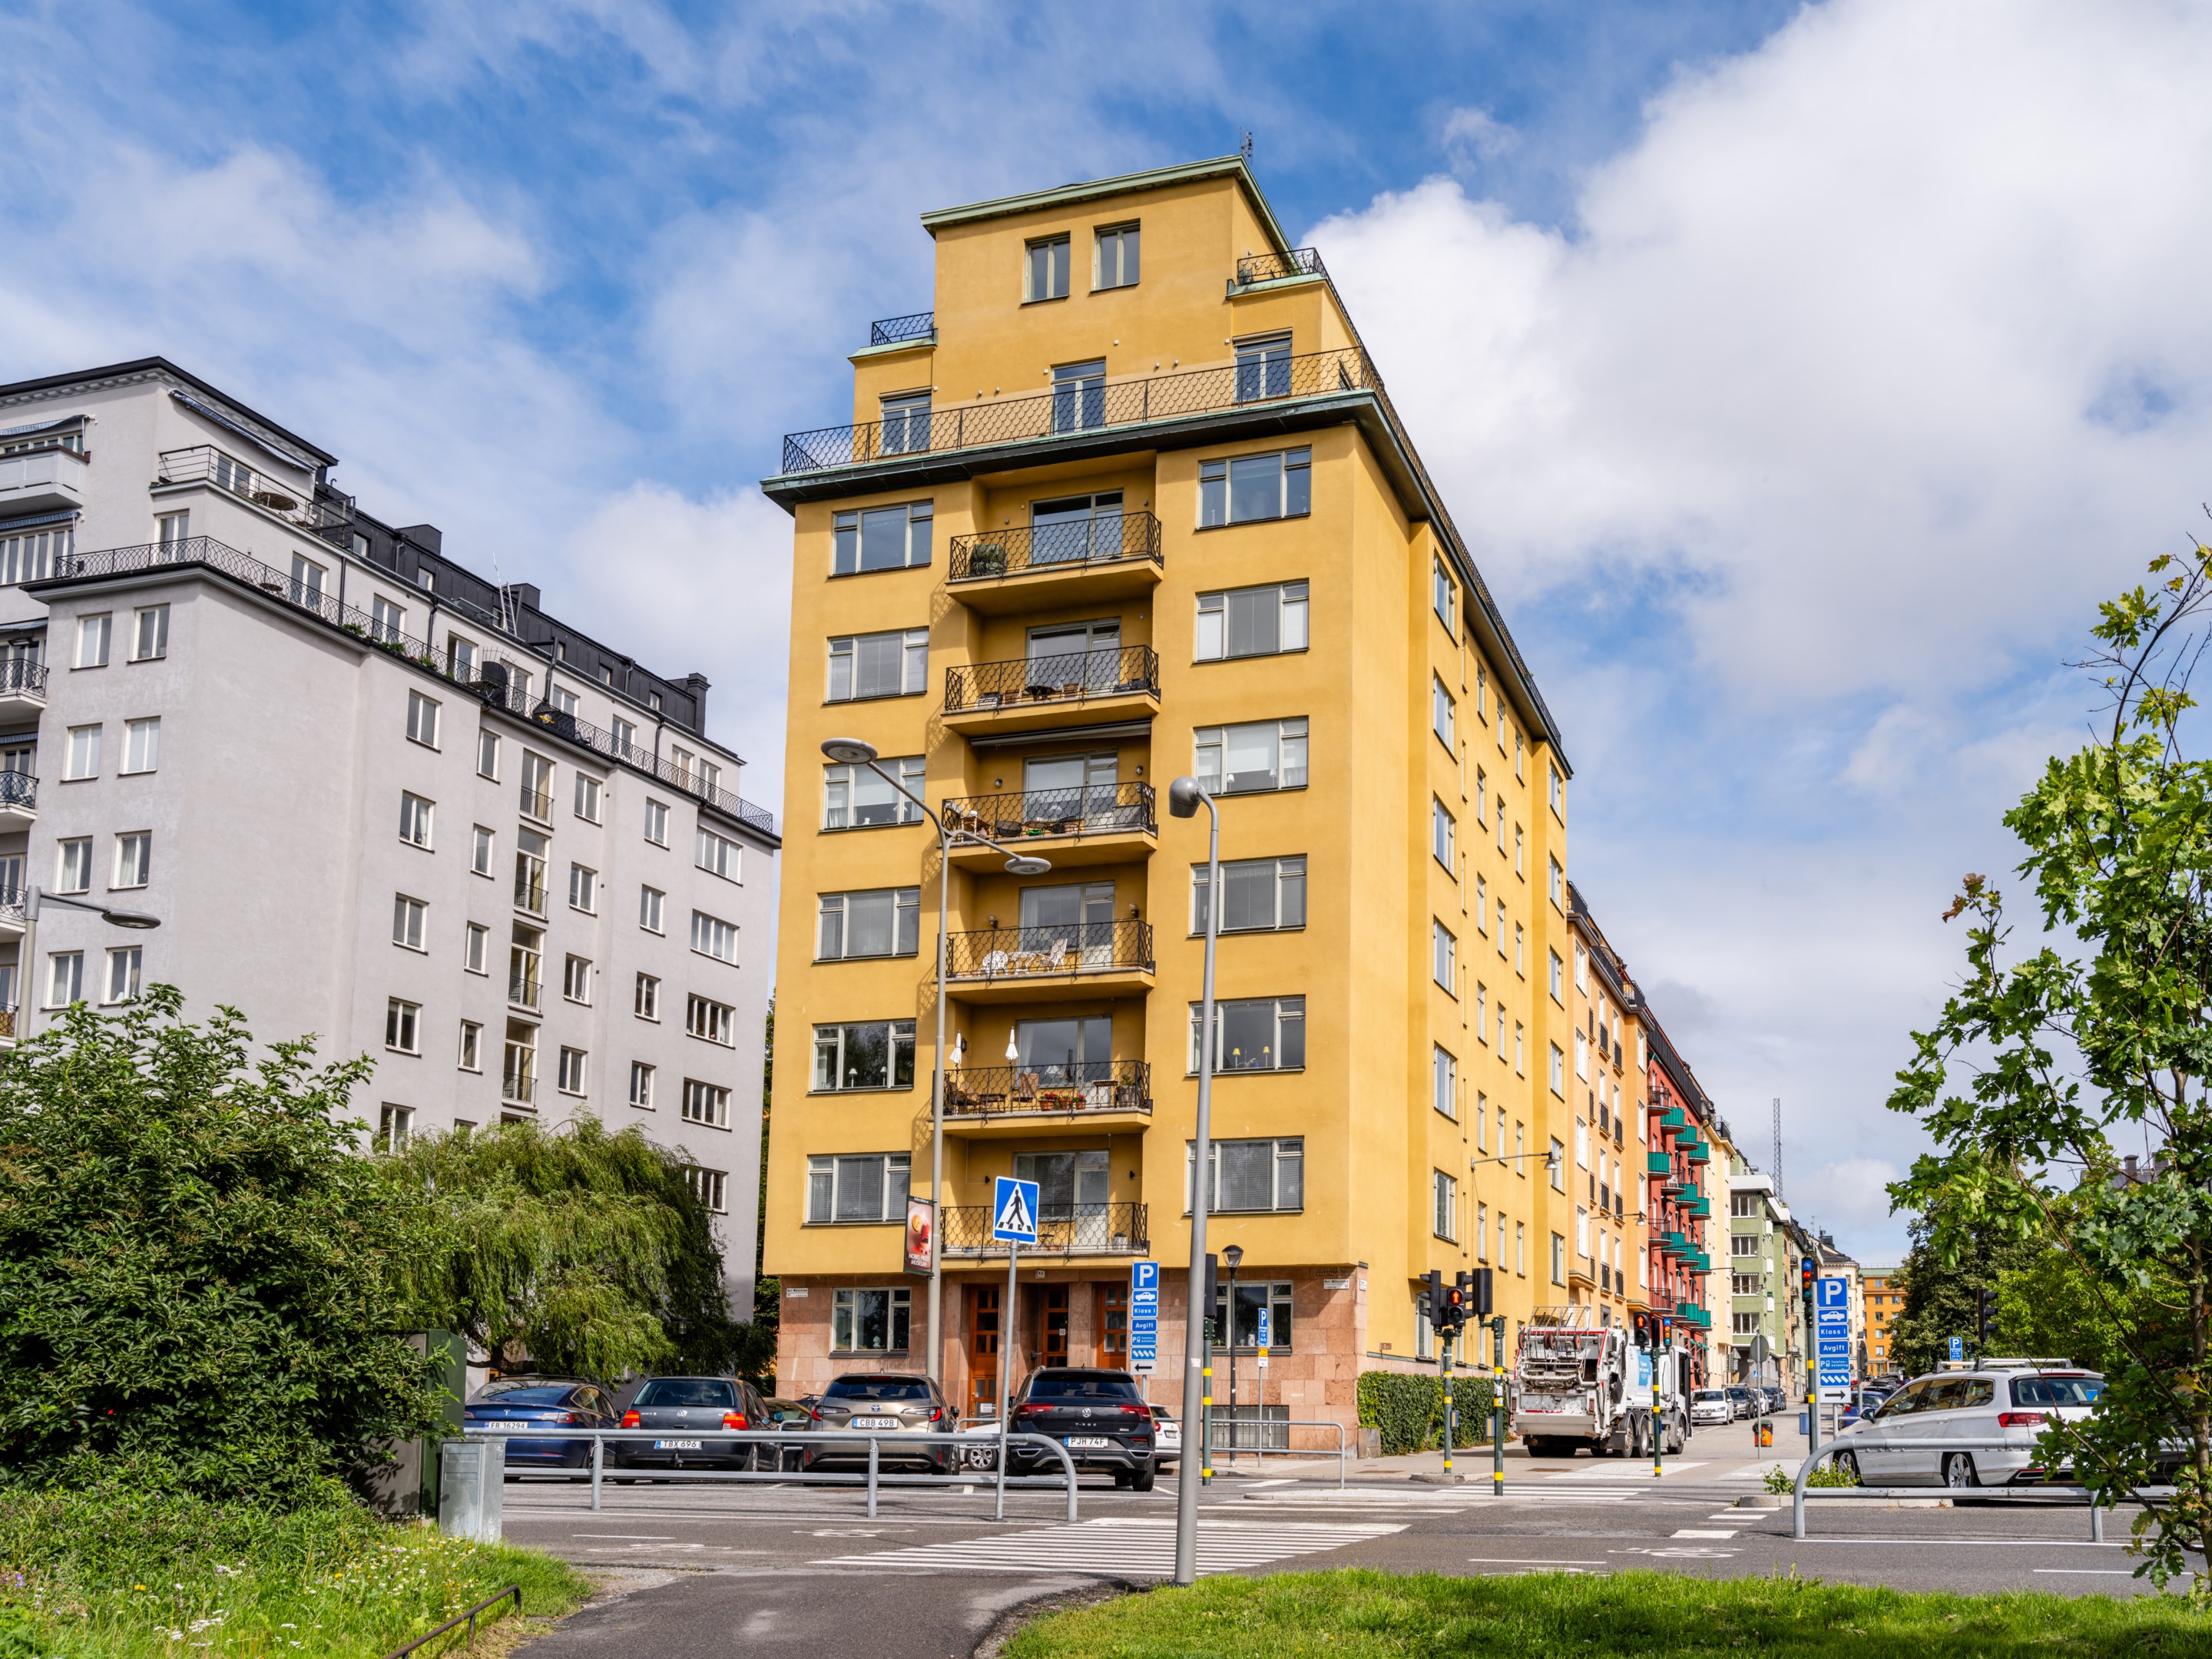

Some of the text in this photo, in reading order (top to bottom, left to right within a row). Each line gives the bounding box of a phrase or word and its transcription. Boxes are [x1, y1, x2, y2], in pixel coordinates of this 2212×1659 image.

[1139, 1264, 1154, 1286] P
[1825, 1280, 1843, 1305] P
[1261, 1310, 1267, 1326] P
[1952, 1339, 1959, 1348] P
